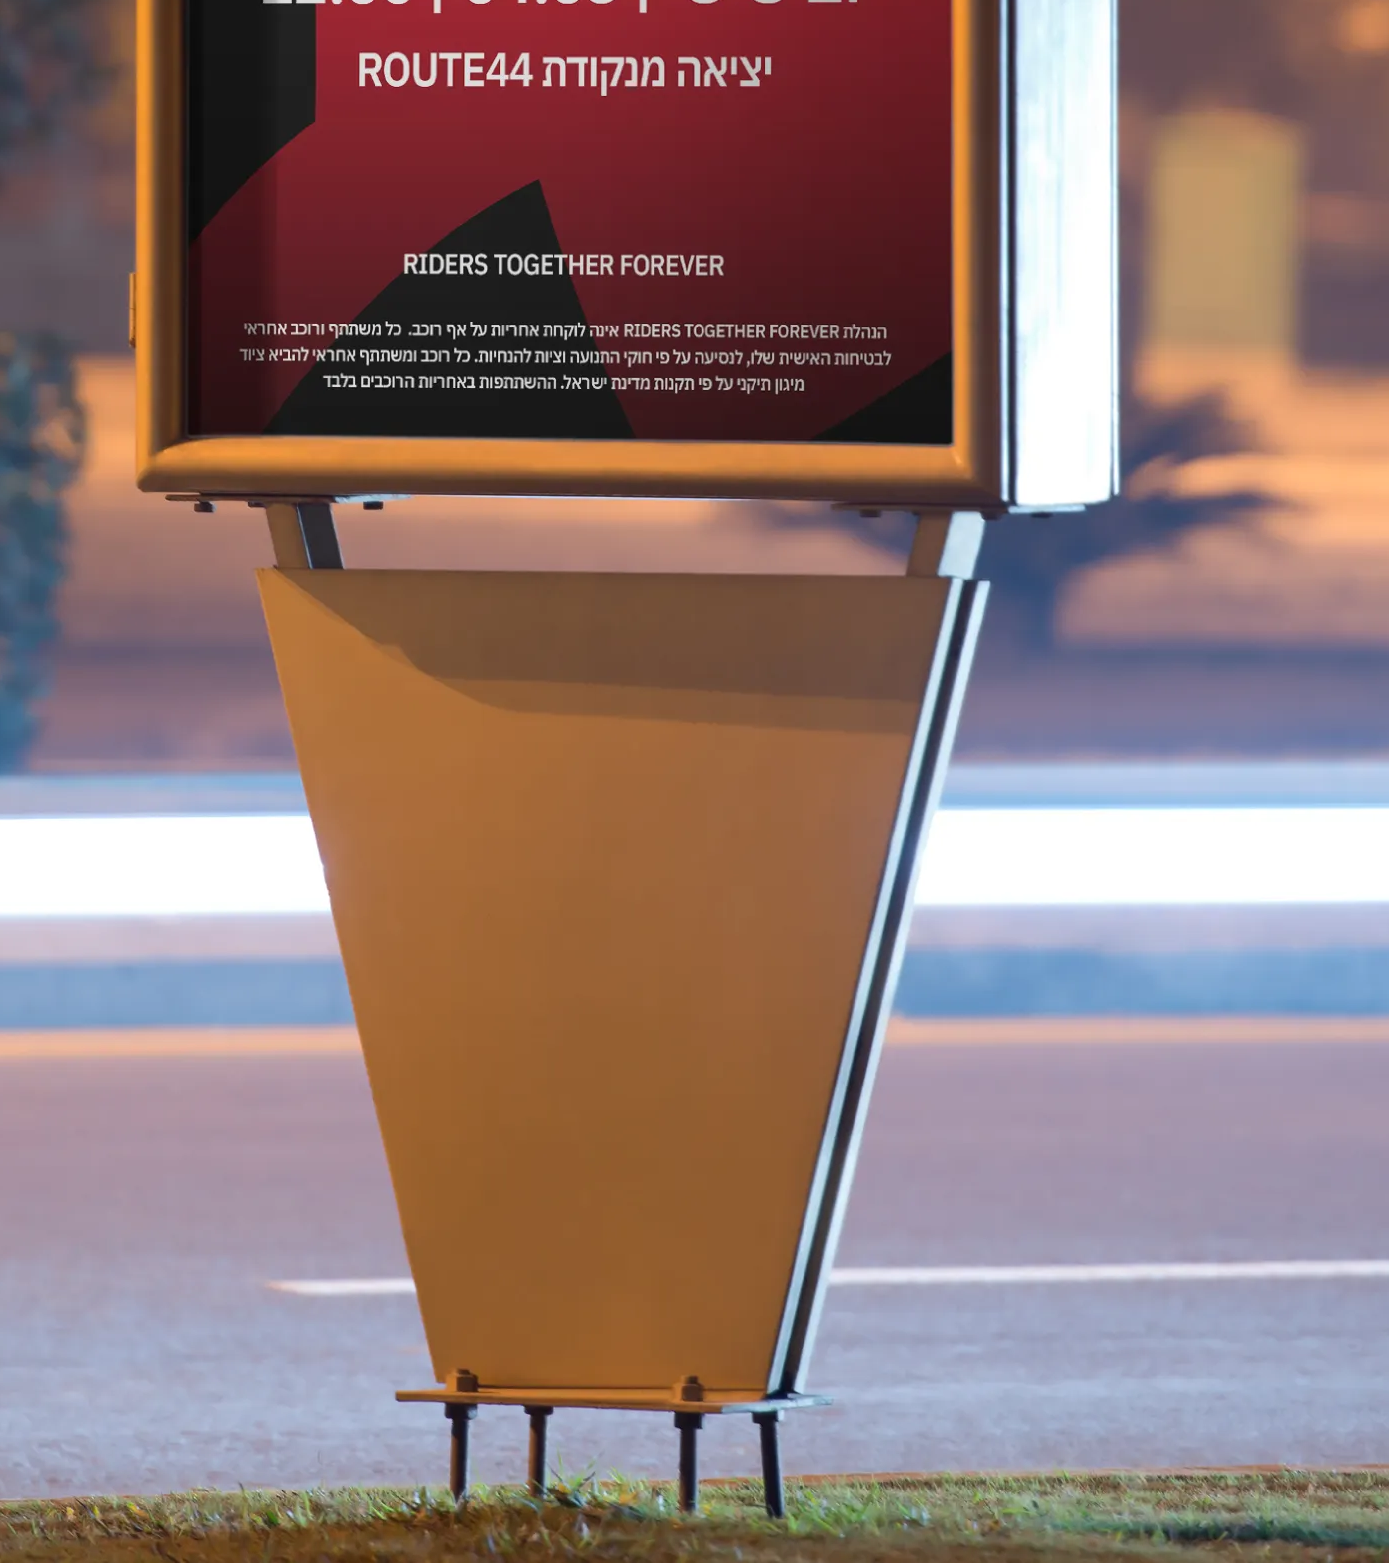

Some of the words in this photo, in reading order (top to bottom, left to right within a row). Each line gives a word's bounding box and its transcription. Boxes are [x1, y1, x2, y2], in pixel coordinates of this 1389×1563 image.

[358, 51, 534, 88] ROUTE44
[542, 56, 665, 97] מנקודת
[677, 56, 772, 87] יציאה
[403, 252, 489, 276] RIDERS
[493, 253, 614, 276] TOGETHER
[620, 253, 725, 277] FOREVER
[243, 322, 288, 336] אחראי
[290, 323, 326, 336] ורוכב
[328, 323, 382, 340] משתתף
[384, 320, 402, 337] כל
[407, 323, 443, 337] רוכב.
[446, 324, 467, 341] אף
[469, 321, 488, 338] על
[490, 324, 540, 337] אחריות
[542, 321, 587, 341] לוקחת
[589, 324, 620, 338] אינה
[623, 323, 682, 338] RIDERS
[683, 323, 766, 339] TOGETHER
[769, 324, 840, 339] FOREVER
[842, 323, 888, 339] הנהלת
[239, 348, 265, 362] ציוד
[268, 346, 310, 362] להביא
[311, 348, 356, 363] אחראי
[359, 348, 418, 367] ומשתתף
[420, 349, 451, 363] רוכב
[453, 346, 471, 363] כל
[474, 347, 533, 364] להנחיות.
[534, 350, 566, 364] וציות
[569, 350, 621, 365] התנועה
[623, 350, 653, 368] חוקי
[655, 350, 671, 365] פי
[672, 348, 692, 366] על
[694, 349, 744, 365] לנסיעה
[746, 349, 775, 368] שלו,
[778, 351, 831, 366] האישית
[834, 350, 892, 366] לבטיחות
[322, 372, 358, 388] בלבד
[360, 375, 415, 389] הרוכבים
[417, 375, 477, 389] באחריות
[478, 376, 557, 390] ההשתתפות
[560, 374, 608, 390] ישראל.
[610, 377, 651, 391] מדינת
[653, 377, 695, 395] תקנות
[698, 377, 713, 391] פי
[714, 375, 734, 391] על
[736, 377, 771, 395] תיקני
[774, 378, 805, 395] מיגון
